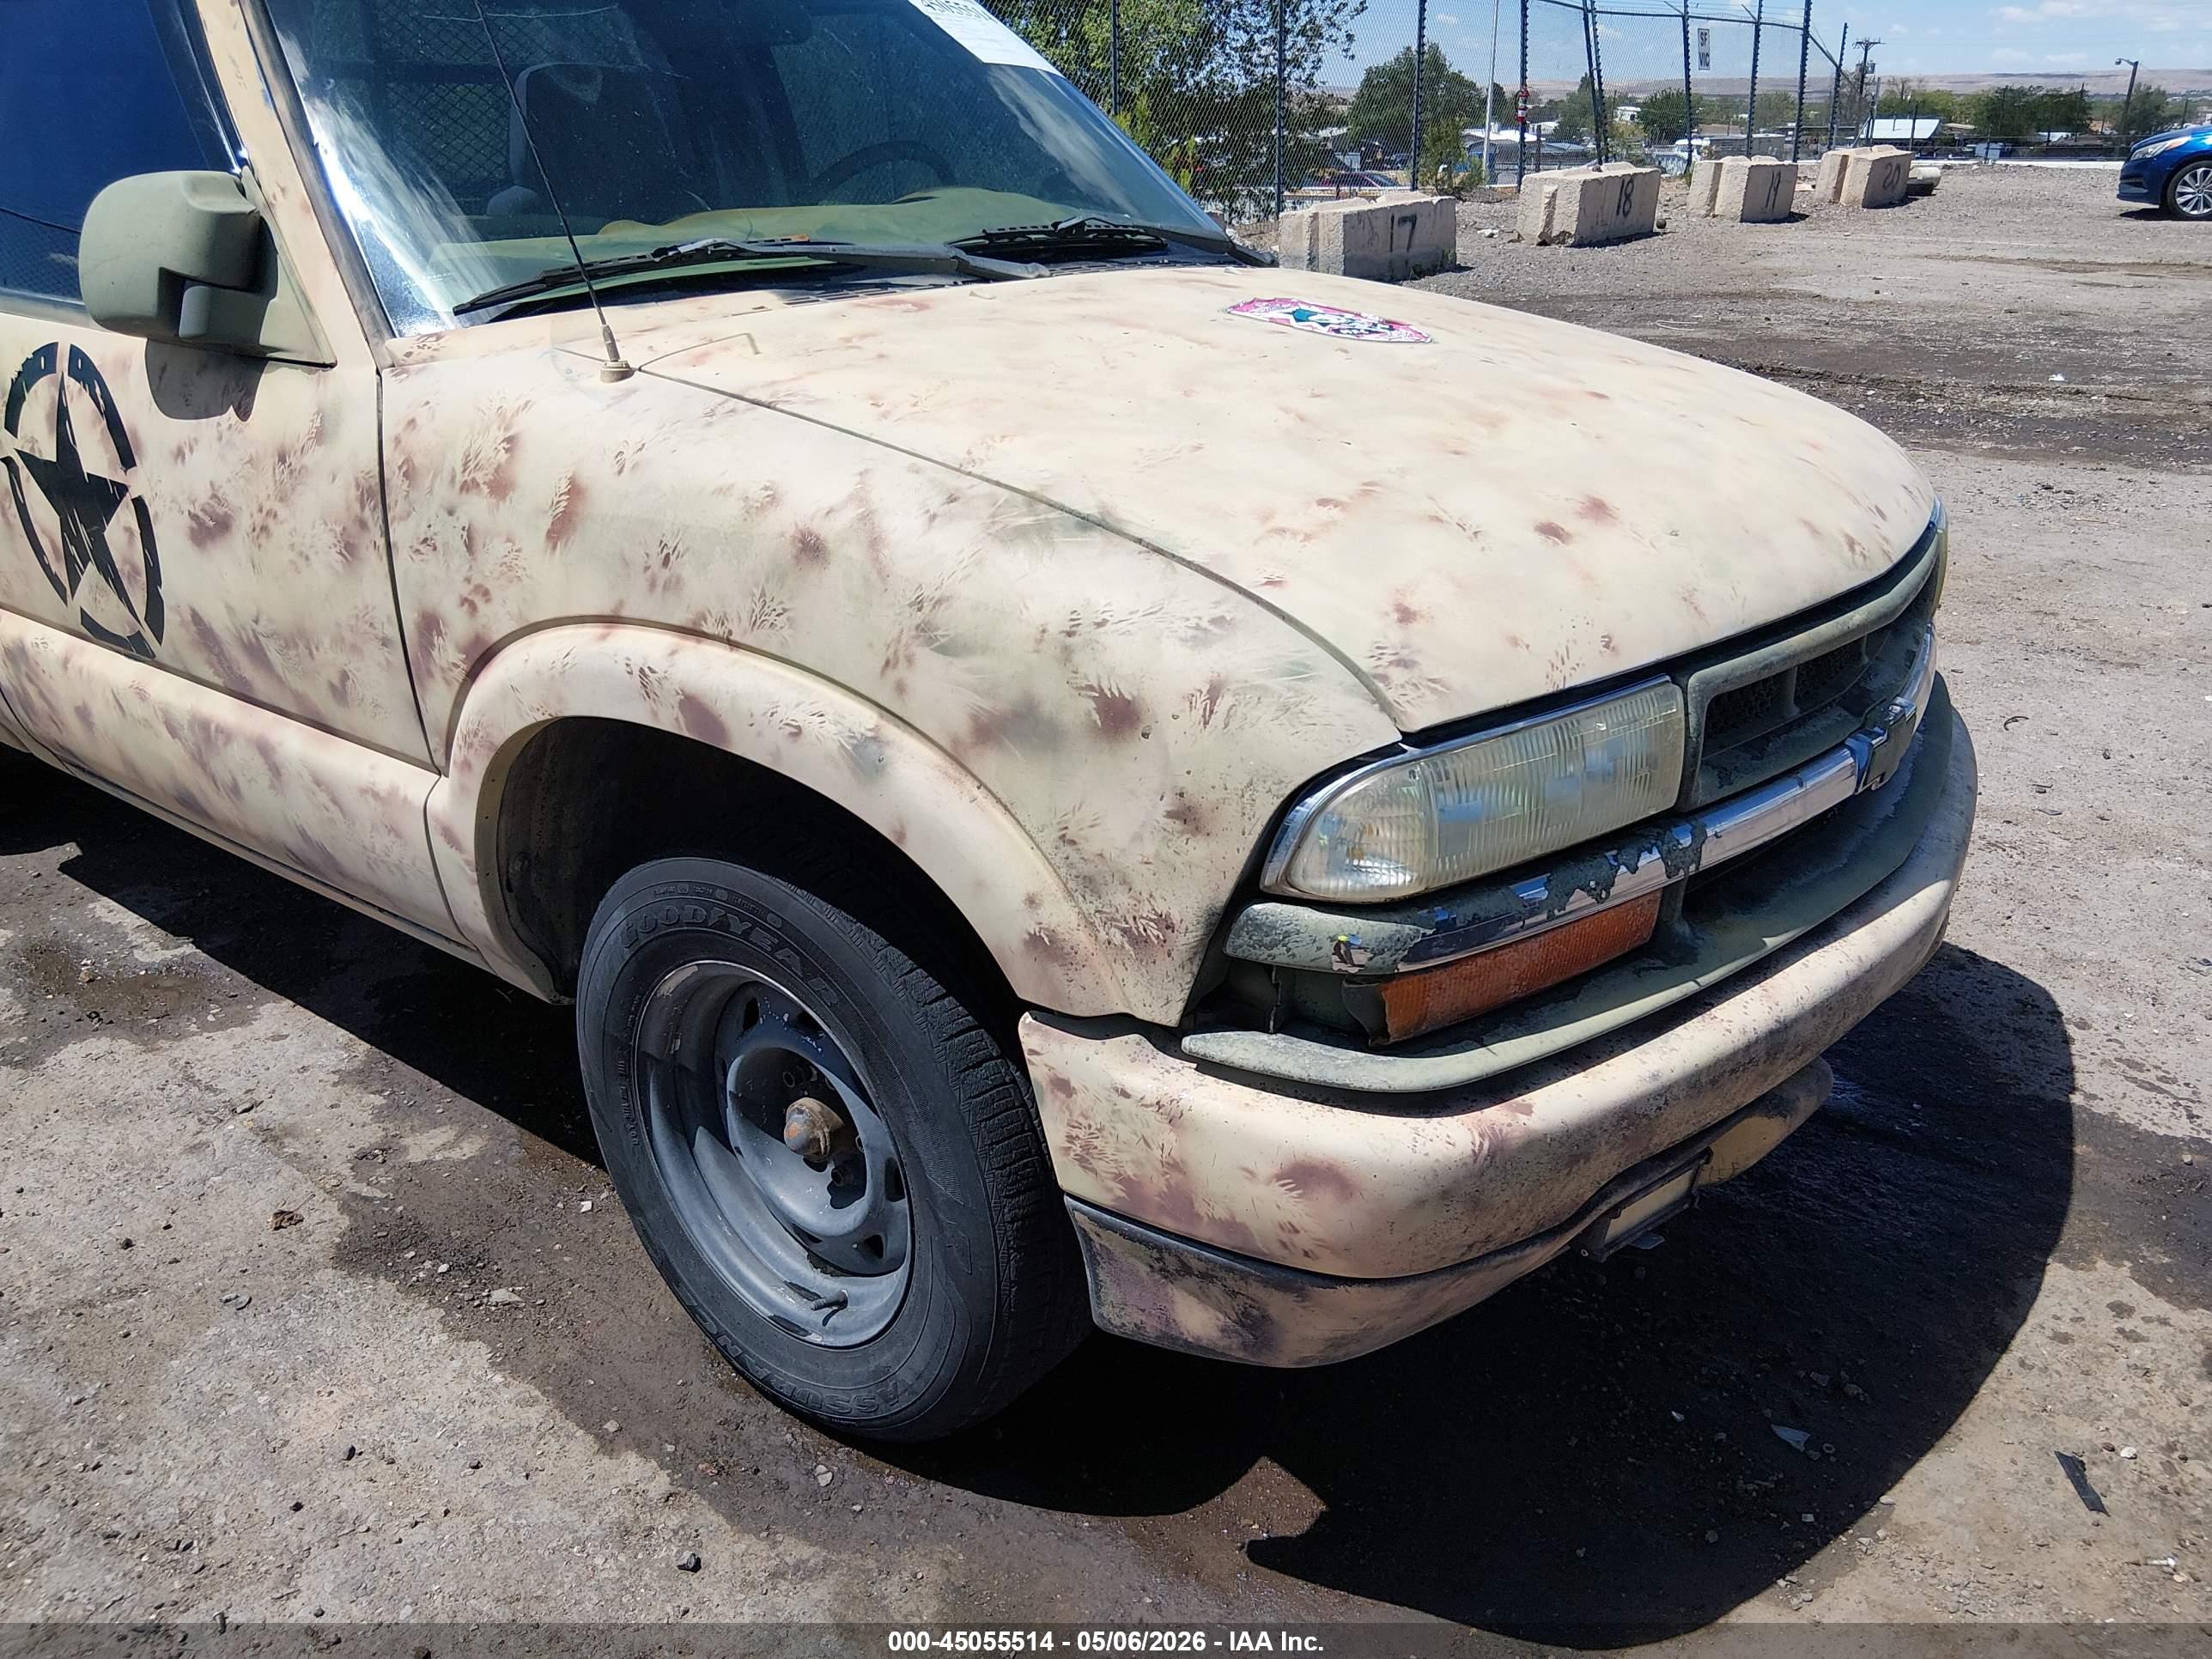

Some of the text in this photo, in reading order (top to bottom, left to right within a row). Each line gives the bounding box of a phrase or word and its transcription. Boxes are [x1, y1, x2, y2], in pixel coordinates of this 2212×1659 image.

[1700, 31, 1708, 46] SF
[1881, 162, 1901, 191] 20
[1616, 178, 1635, 217] 18
[1389, 213, 1418, 252] 17
[623, 904, 840, 1006] GOODYEAR
